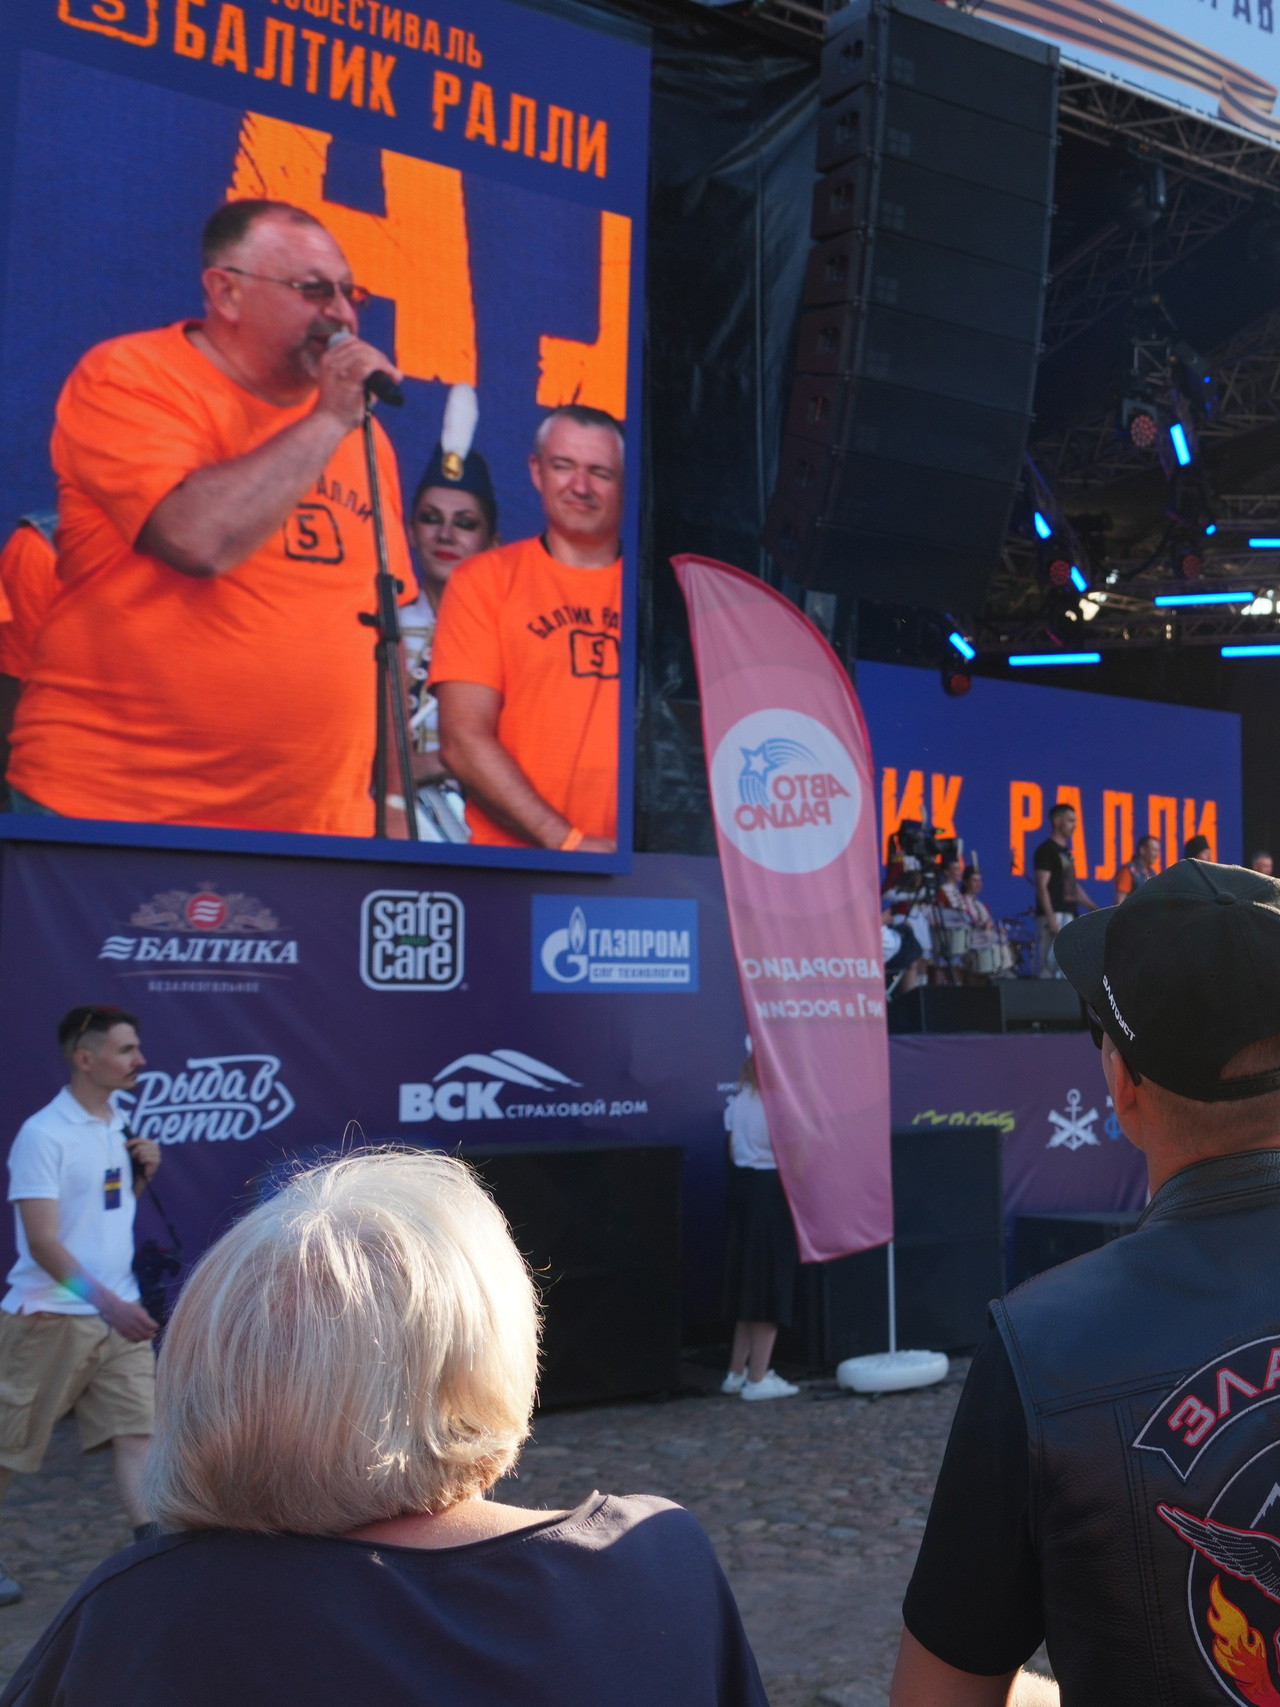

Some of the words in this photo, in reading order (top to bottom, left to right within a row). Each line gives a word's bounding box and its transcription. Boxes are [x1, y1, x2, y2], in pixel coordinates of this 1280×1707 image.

[174, 0, 396, 117] БАЛТИК
[432, 70, 607, 178] РАЛЛИ
[1010, 781, 1217, 881] РАЛЛИ
[373, 892, 453, 941] safe
[134, 937, 299, 963] БАЛТИКА
[372, 940, 453, 982] care
[588, 928, 690, 958] ГАЗПРОМ
[399, 1081, 505, 1122] ВСК
[505, 1098, 606, 1119] СТРАХОВОЙ
[609, 1100, 649, 1117] ДОМ
